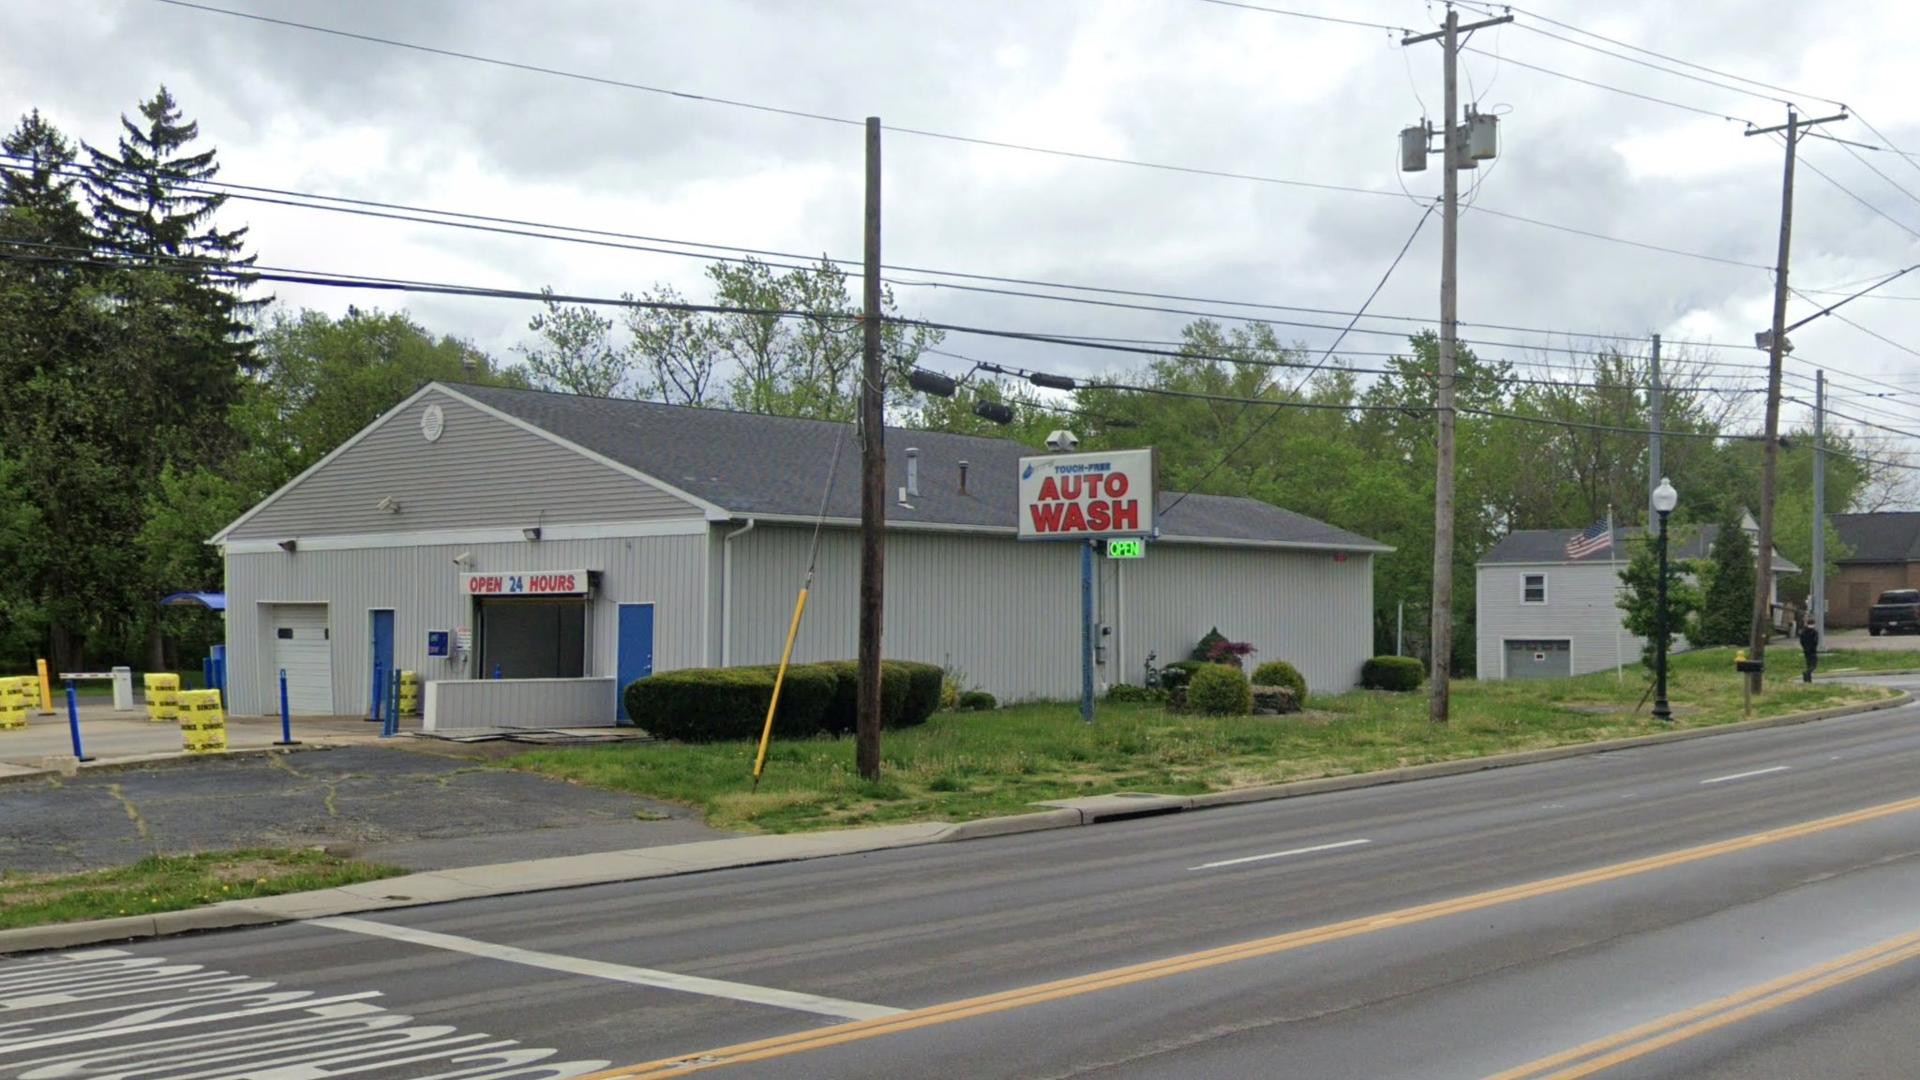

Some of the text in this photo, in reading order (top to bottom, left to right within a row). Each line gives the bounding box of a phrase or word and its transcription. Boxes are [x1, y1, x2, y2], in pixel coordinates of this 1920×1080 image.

[1055, 463, 1111, 474] TOUCH-FREE
[1038, 471, 1129, 501] AUTO
[1029, 499, 1138, 533] WASH
[1109, 541, 1139, 557] OPEN
[469, 574, 576, 593] OPEN 24 HOURS
